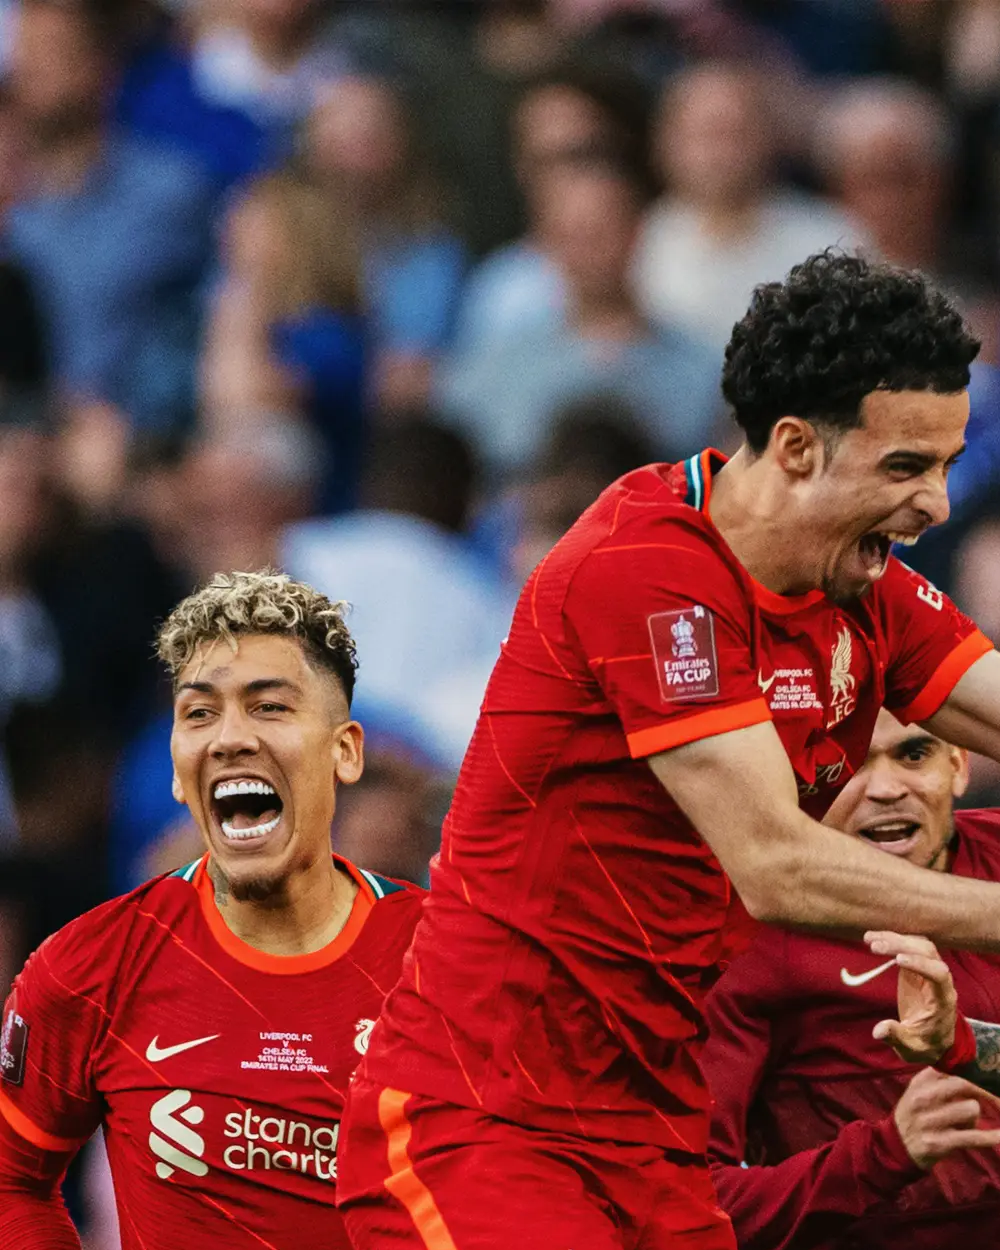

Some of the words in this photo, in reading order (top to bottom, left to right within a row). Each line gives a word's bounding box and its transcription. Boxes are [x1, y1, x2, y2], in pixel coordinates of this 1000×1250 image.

[664, 658, 709, 672] Emirates
[666, 672, 683, 685] FA
[684, 668, 711, 682] CUP
[260, 1032, 301, 1041] LIVERPOOL
[262, 1047, 295, 1056] CHELSEA
[277, 1056, 294, 1064] MAY
[224, 1108, 339, 1152] stand
[223, 1140, 337, 1179] charte
